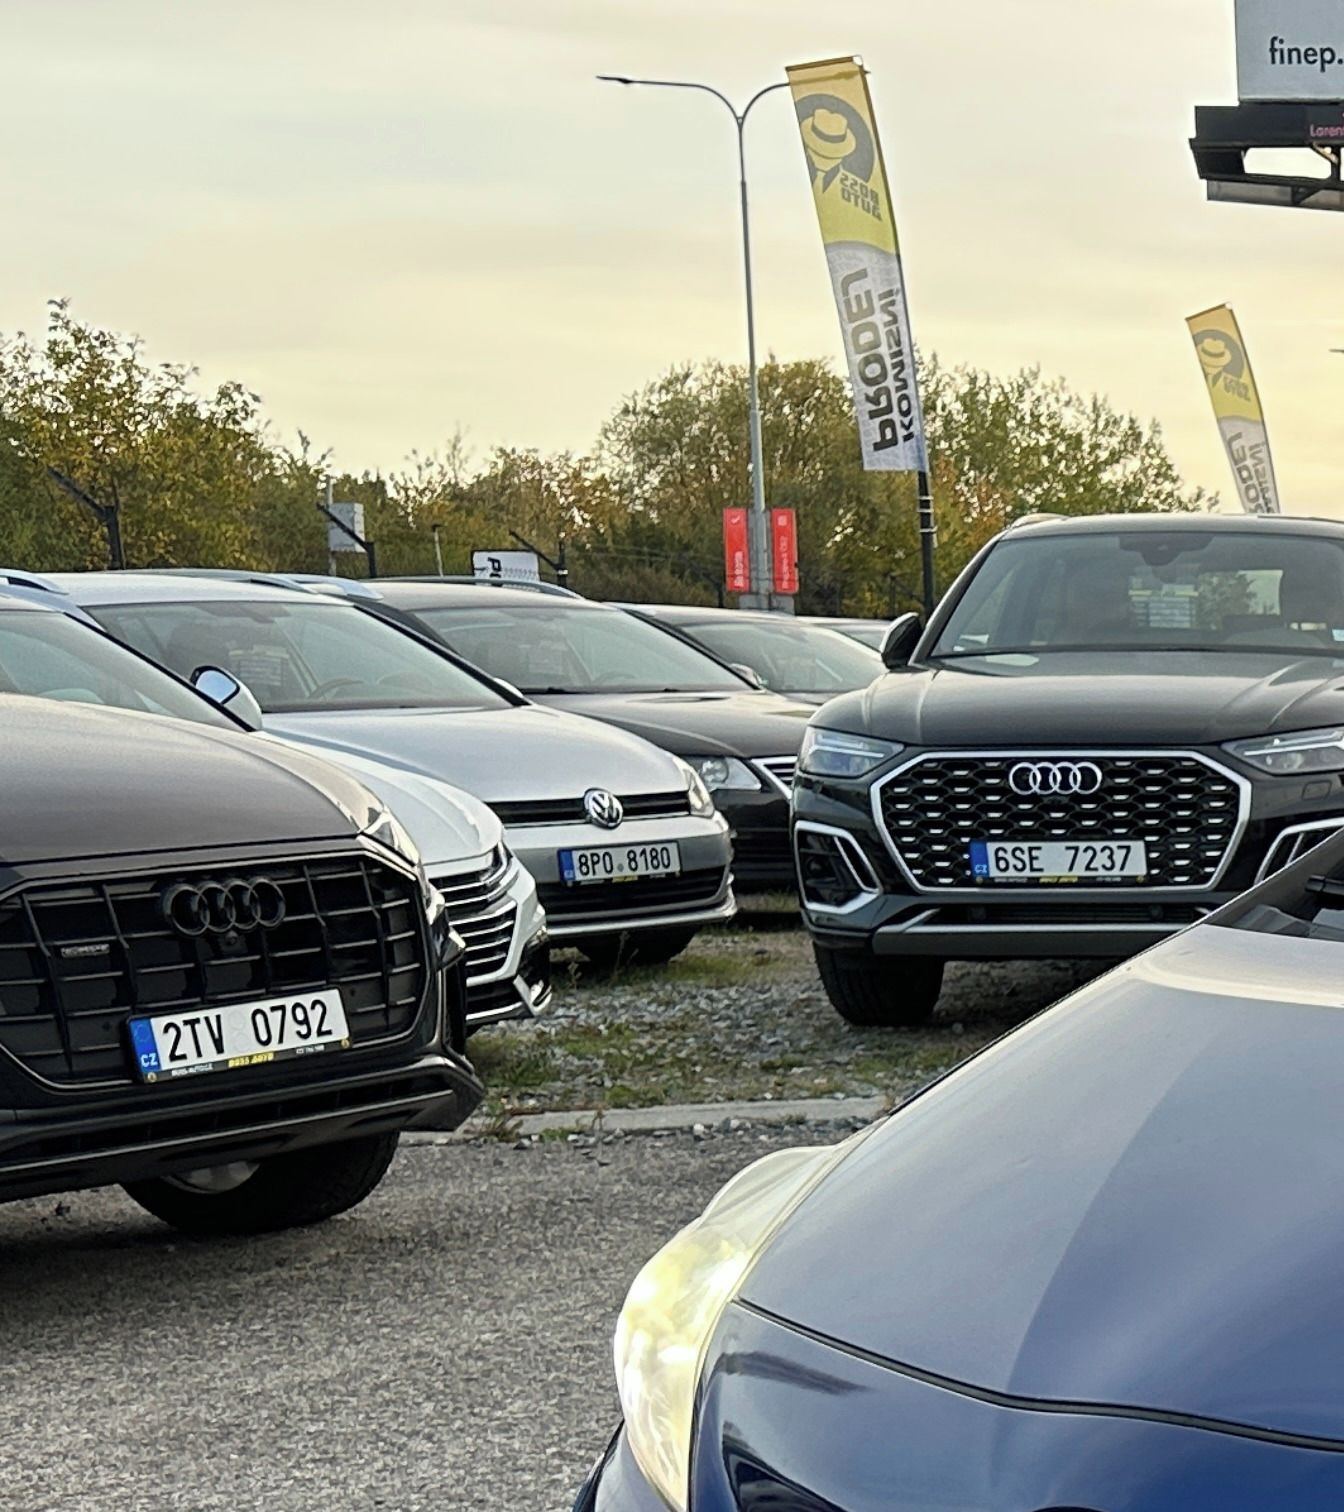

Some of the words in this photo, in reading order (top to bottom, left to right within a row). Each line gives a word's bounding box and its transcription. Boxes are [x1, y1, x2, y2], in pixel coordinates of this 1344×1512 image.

[626, 846, 671, 872] 8180
[994, 846, 1045, 873] 6SE
[1064, 845, 1132, 873] 7237
[162, 1013, 226, 1063] 2TV
[250, 999, 333, 1047] 0792
[140, 1053, 158, 1068] CZ
